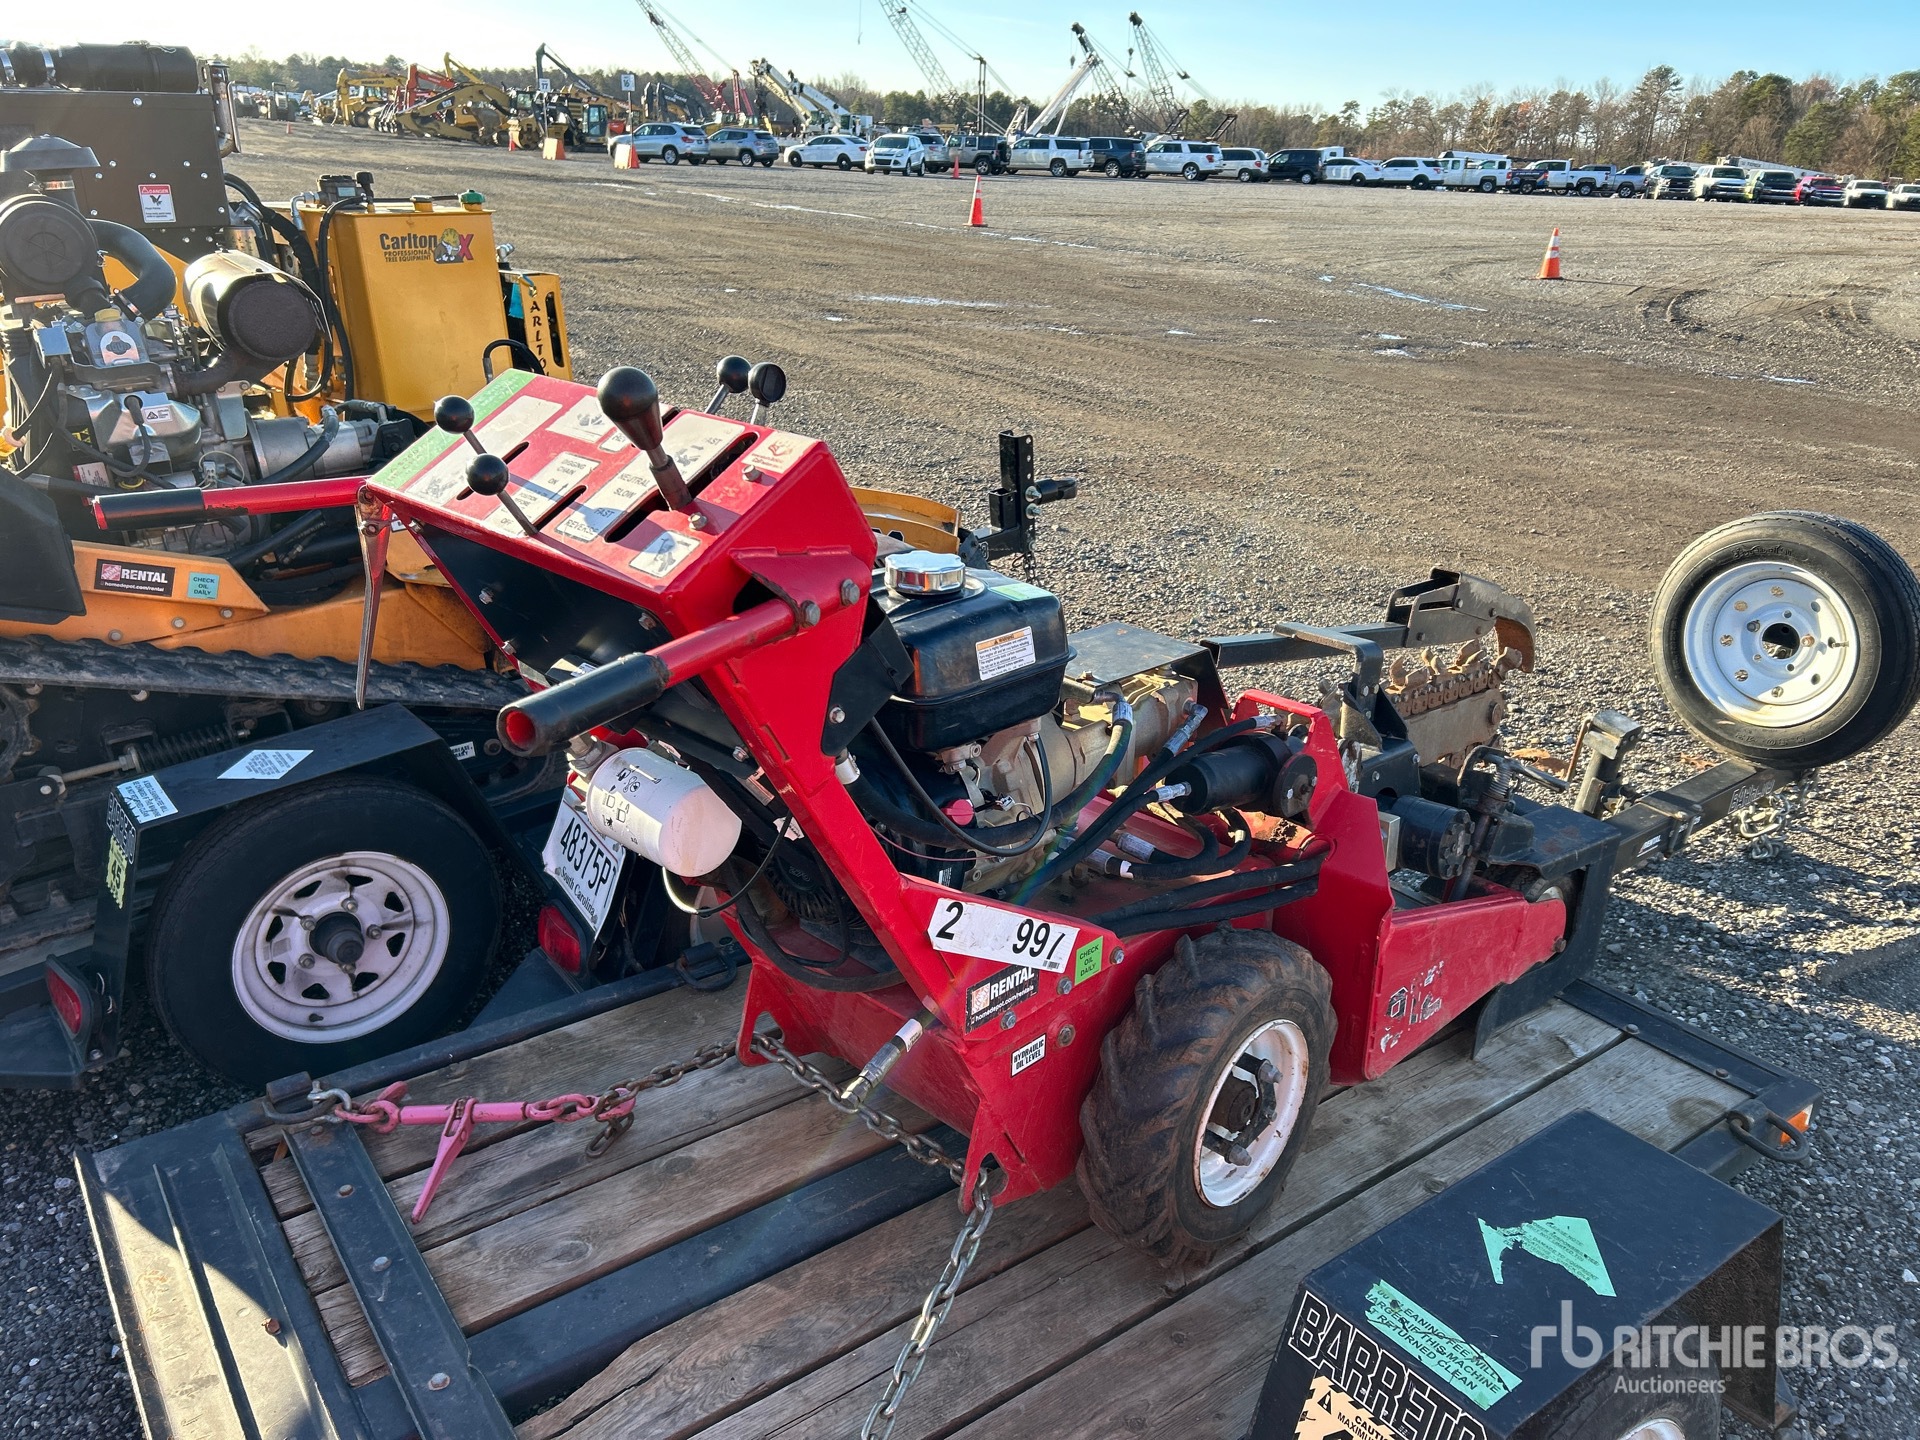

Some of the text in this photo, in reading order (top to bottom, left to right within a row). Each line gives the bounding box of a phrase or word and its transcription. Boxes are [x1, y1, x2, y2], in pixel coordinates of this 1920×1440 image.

[379, 233, 438, 250] Carlton
[384, 249, 431, 257] PROFESSIONAL
[620, 473, 650, 488] NEUTRAL
[613, 487, 637, 499] SLOW
[594, 507, 616, 518] FAST
[564, 518, 599, 536] REVERSE
[121, 568, 168, 584] RENTAL
[193, 576, 215, 584] CHECK
[560, 865, 597, 918] South Carolina
[935, 902, 964, 941] 2
[1079, 944, 1099, 960] CHECK
[1080, 962, 1097, 977] DAILY
[1084, 956, 1094, 966] OIL
[990, 966, 1035, 1001] RENTAL
[1013, 1038, 1045, 1064] HYDRAULIC
[1015, 1050, 1042, 1070] OIL LEVEL
[1376, 1311, 1478, 1392] RETURNED CLEAN
[1444, 1337, 1470, 1359] FEE
[1419, 1331, 1449, 1356] THIS
[1444, 1350, 1502, 1396] MACHINE
